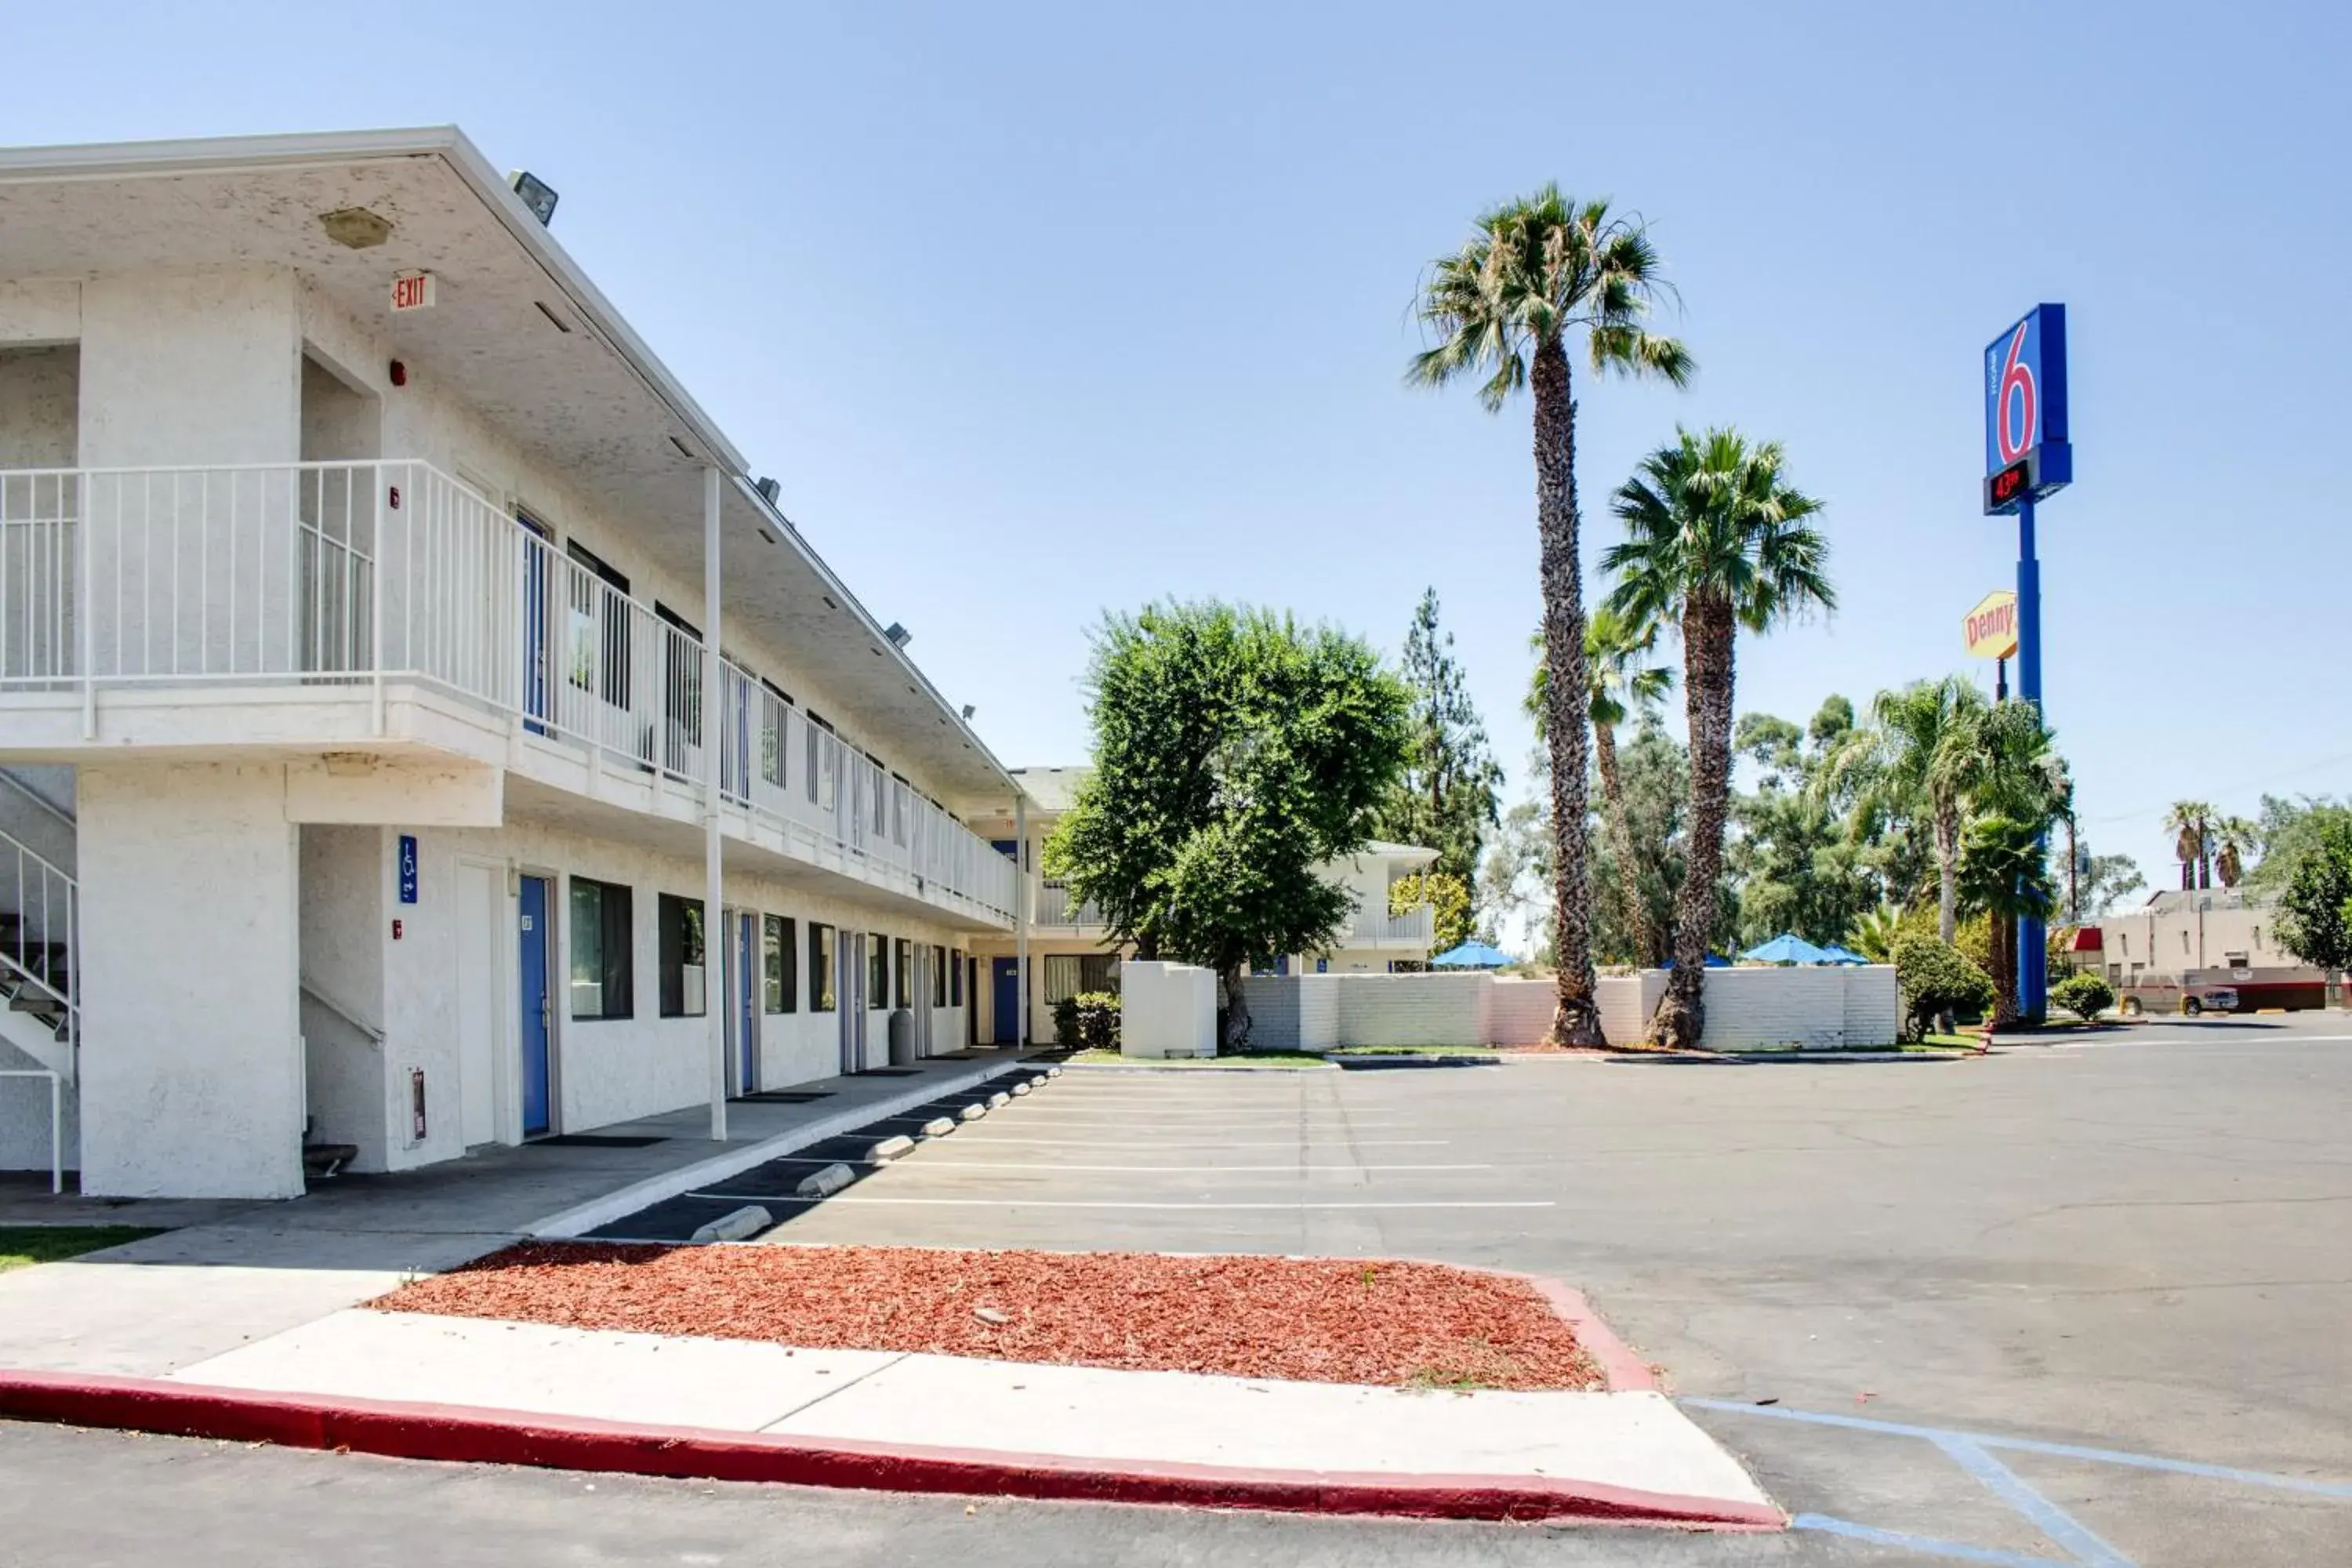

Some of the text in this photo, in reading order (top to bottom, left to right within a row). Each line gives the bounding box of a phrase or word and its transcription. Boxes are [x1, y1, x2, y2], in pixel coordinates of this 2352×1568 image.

[397, 276, 426, 308] EXIT
[1998, 321, 2037, 465] 6
[1967, 601, 2016, 650] Denny
